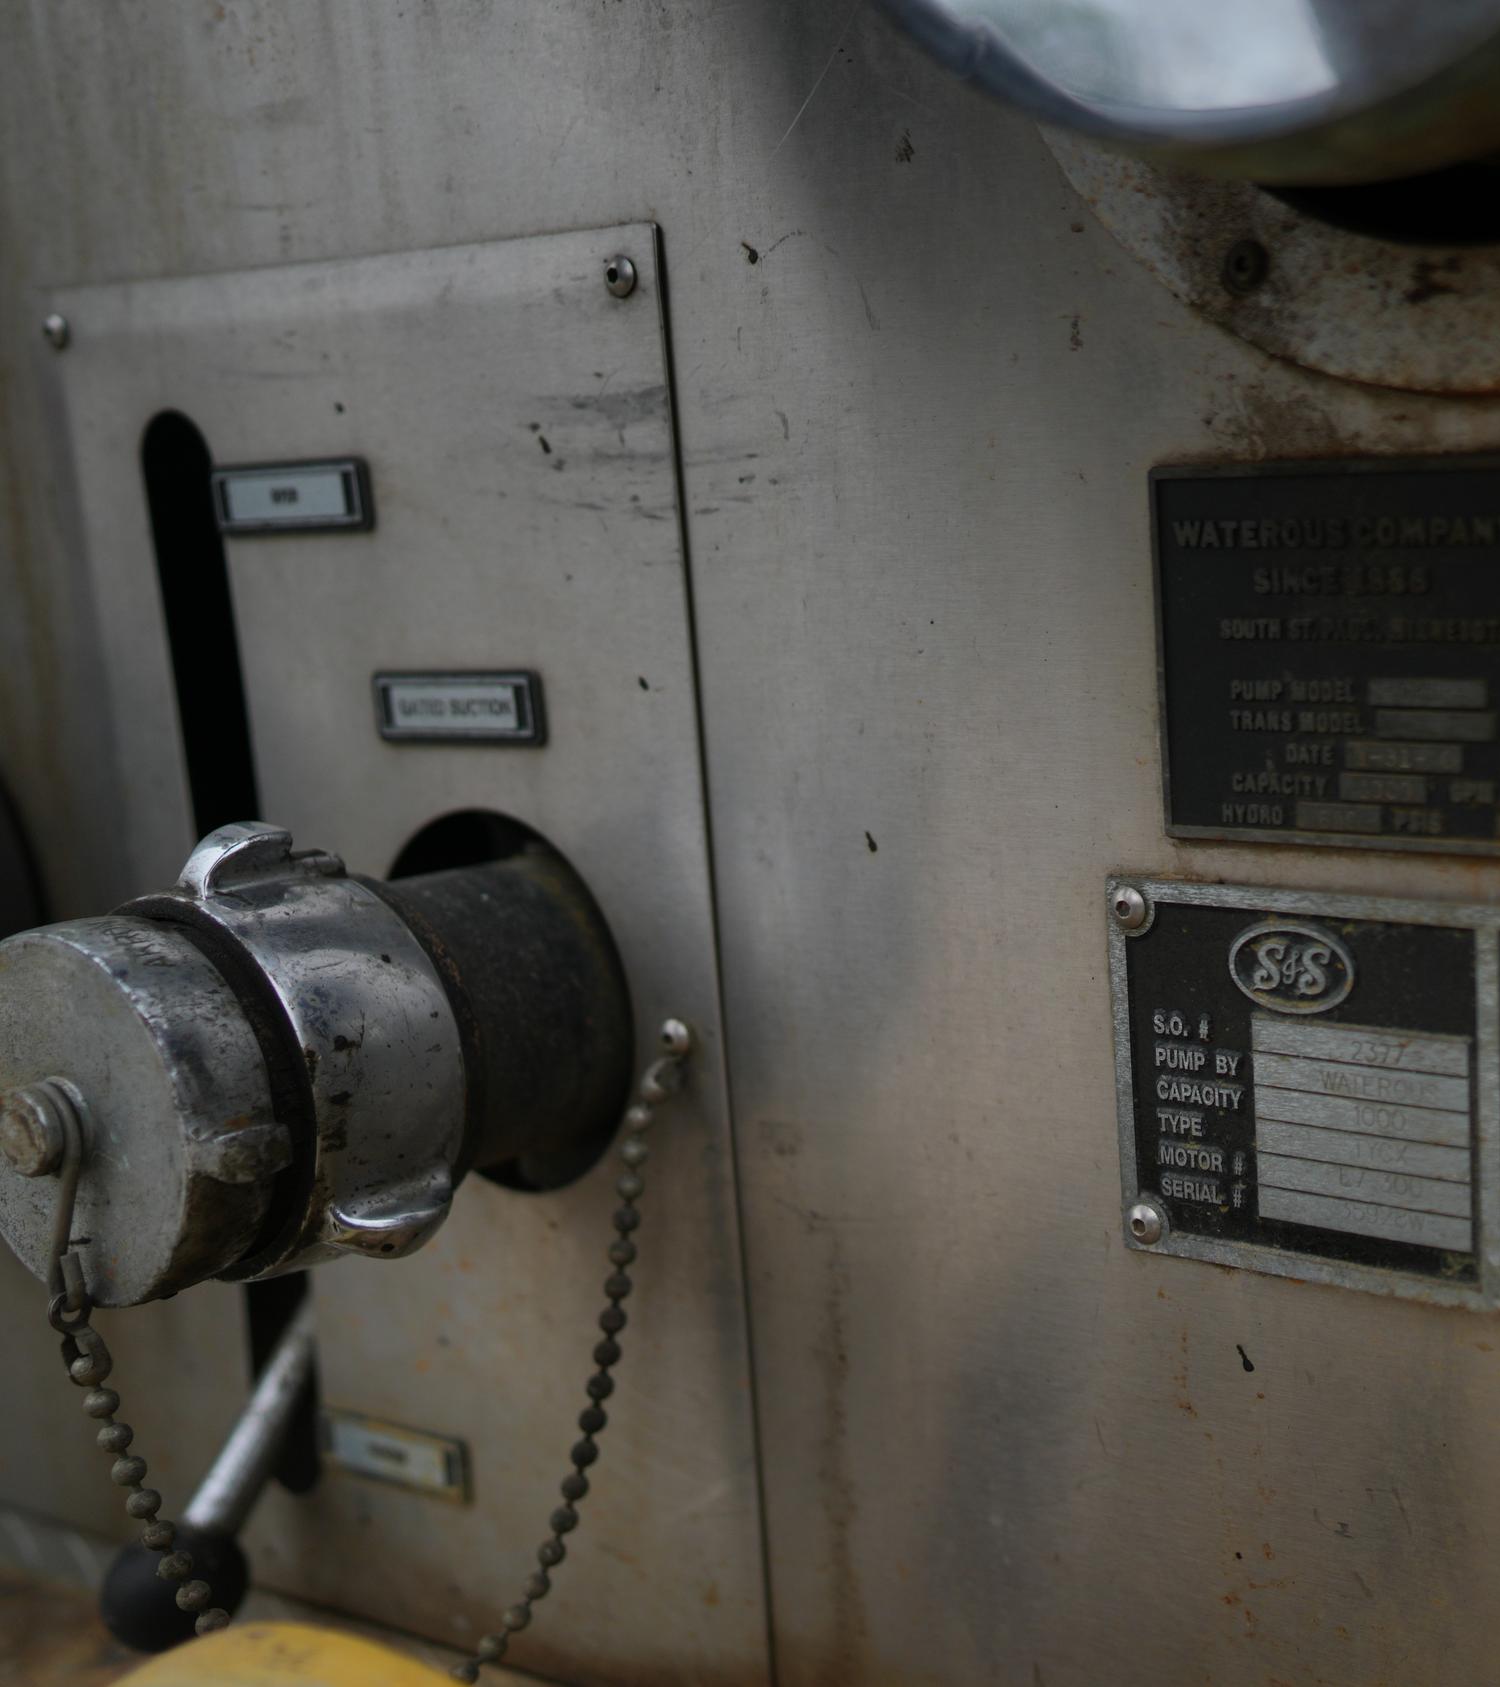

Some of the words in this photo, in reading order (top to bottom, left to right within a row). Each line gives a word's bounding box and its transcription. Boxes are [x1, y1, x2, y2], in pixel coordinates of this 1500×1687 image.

[1173, 519, 1346, 549] WATEROUS
[1252, 567, 1341, 594] SINCE
[1219, 617, 1280, 641] SOUTH
[1230, 678, 1283, 702] PUMP
[1290, 679, 1356, 703] MODEL
[1229, 709, 1293, 733] TRANS
[1298, 709, 1367, 735] MODEL
[1285, 743, 1334, 766] DATE
[1231, 771, 1329, 797] CAPACITY
[1221, 802, 1284, 825] HYDRO
[1252, 942, 1330, 997] S&S
[1154, 1047, 1206, 1072] PUMP
[1215, 1053, 1240, 1077] BY
[1351, 1040, 1406, 1065] 2377
[1156, 1080, 1242, 1110] CAPACITY
[1320, 1068, 1439, 1103] WATEROUS
[1158, 1111, 1204, 1137] TYPE
[1354, 1105, 1406, 1132] 1000
[1159, 1146, 1224, 1174] MOTOR
[1160, 1176, 1222, 1205] SERIAL
